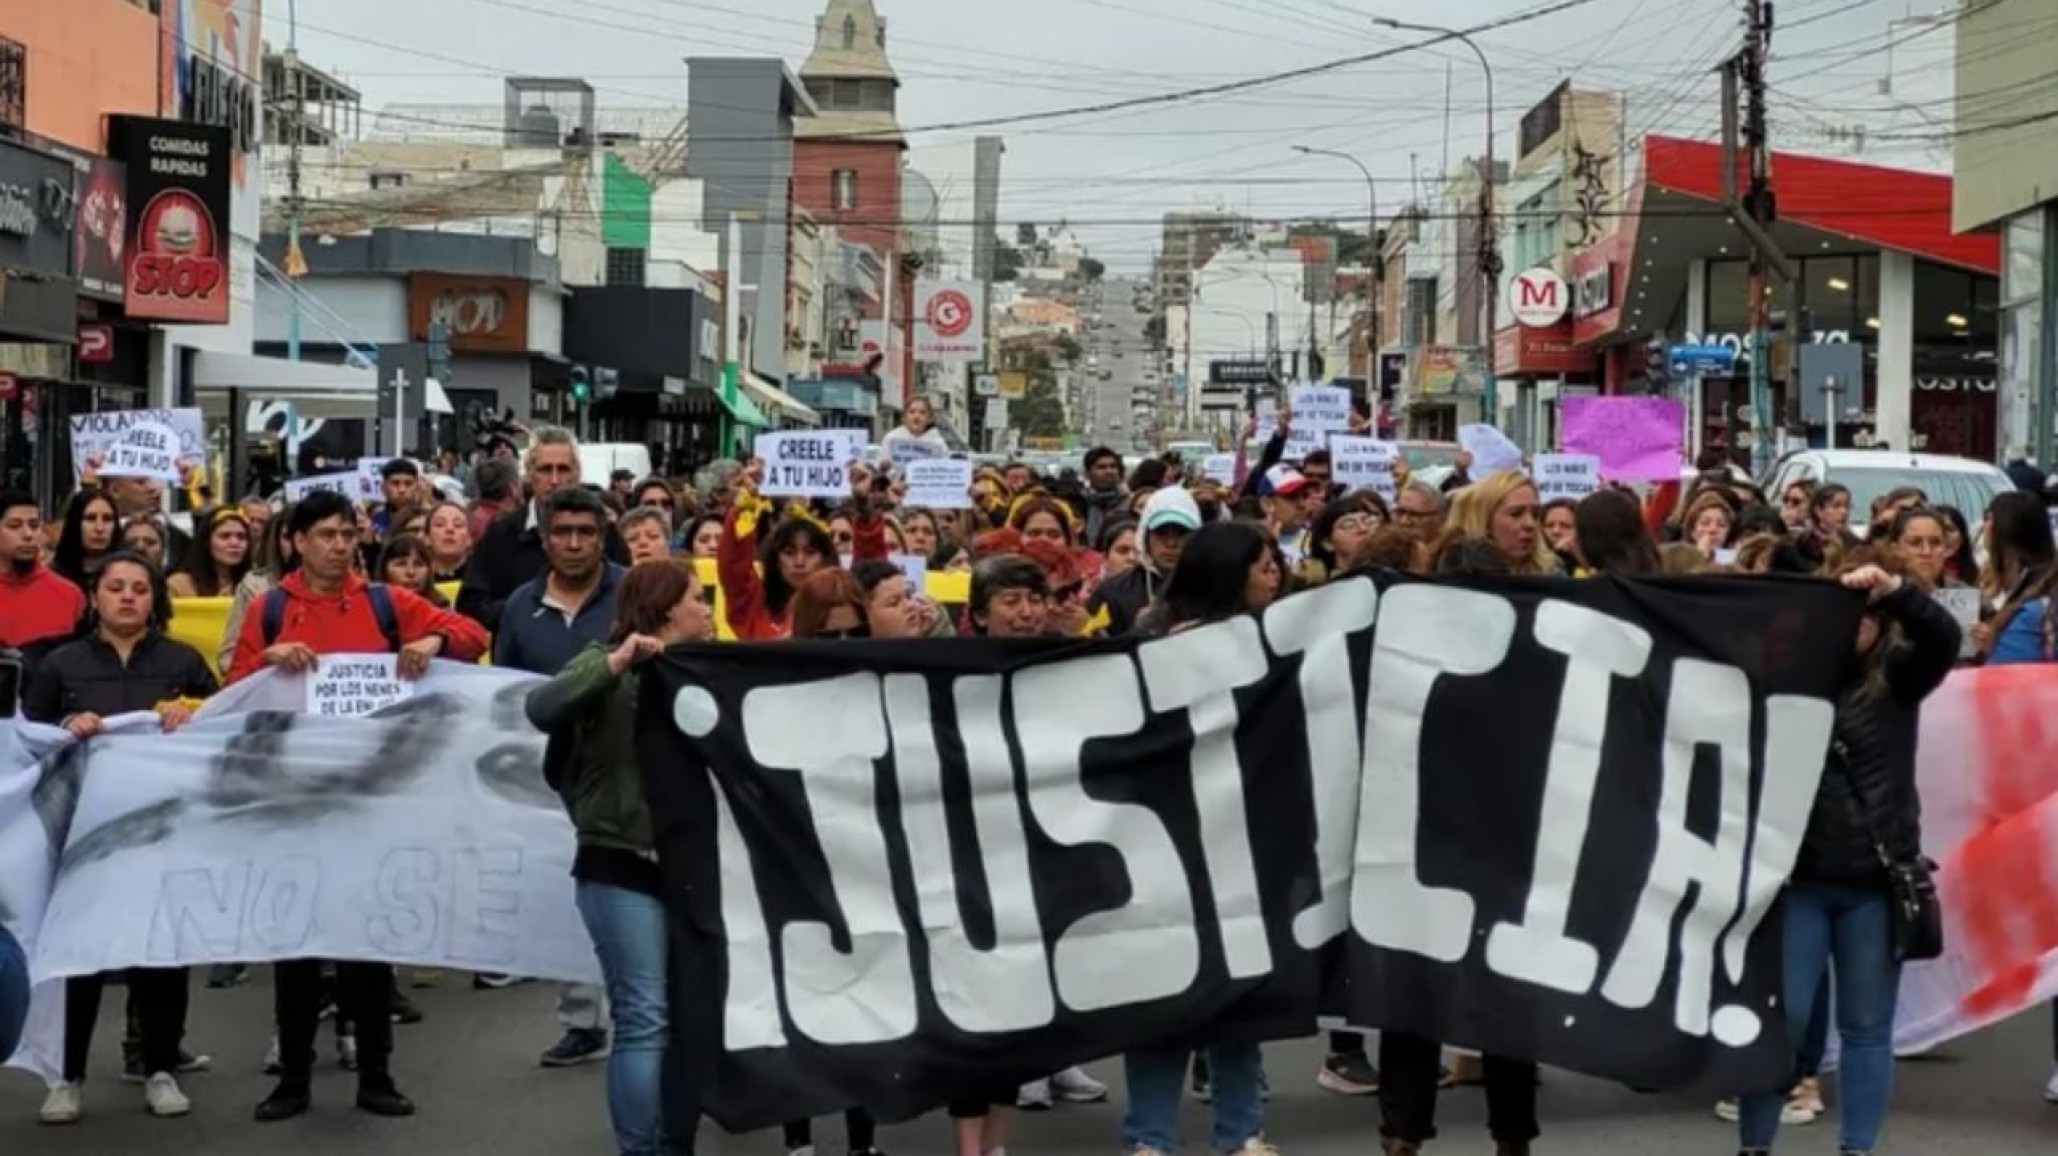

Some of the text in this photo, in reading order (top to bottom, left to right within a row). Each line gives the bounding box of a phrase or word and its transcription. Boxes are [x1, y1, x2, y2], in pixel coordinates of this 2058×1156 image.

[149, 135, 209, 155] COMIDAS
[150, 157, 207, 178] RAPIDAS
[134, 256, 220, 299] STOP
[1518, 277, 1558, 307] M
[120, 449, 138, 467] TU
[778, 438, 834, 461] CREELE
[769, 466, 842, 488] A TU HIJO
[327, 663, 387, 679] JUSTICIA
[315, 682, 337, 698] POR
[340, 681, 362, 698] LOS
[321, 700, 336, 715] DE
[340, 699, 353, 714] LA
[673, 576, 1835, 1052] ¡JUSTICIA!
[148, 848, 524, 964] NO SE
